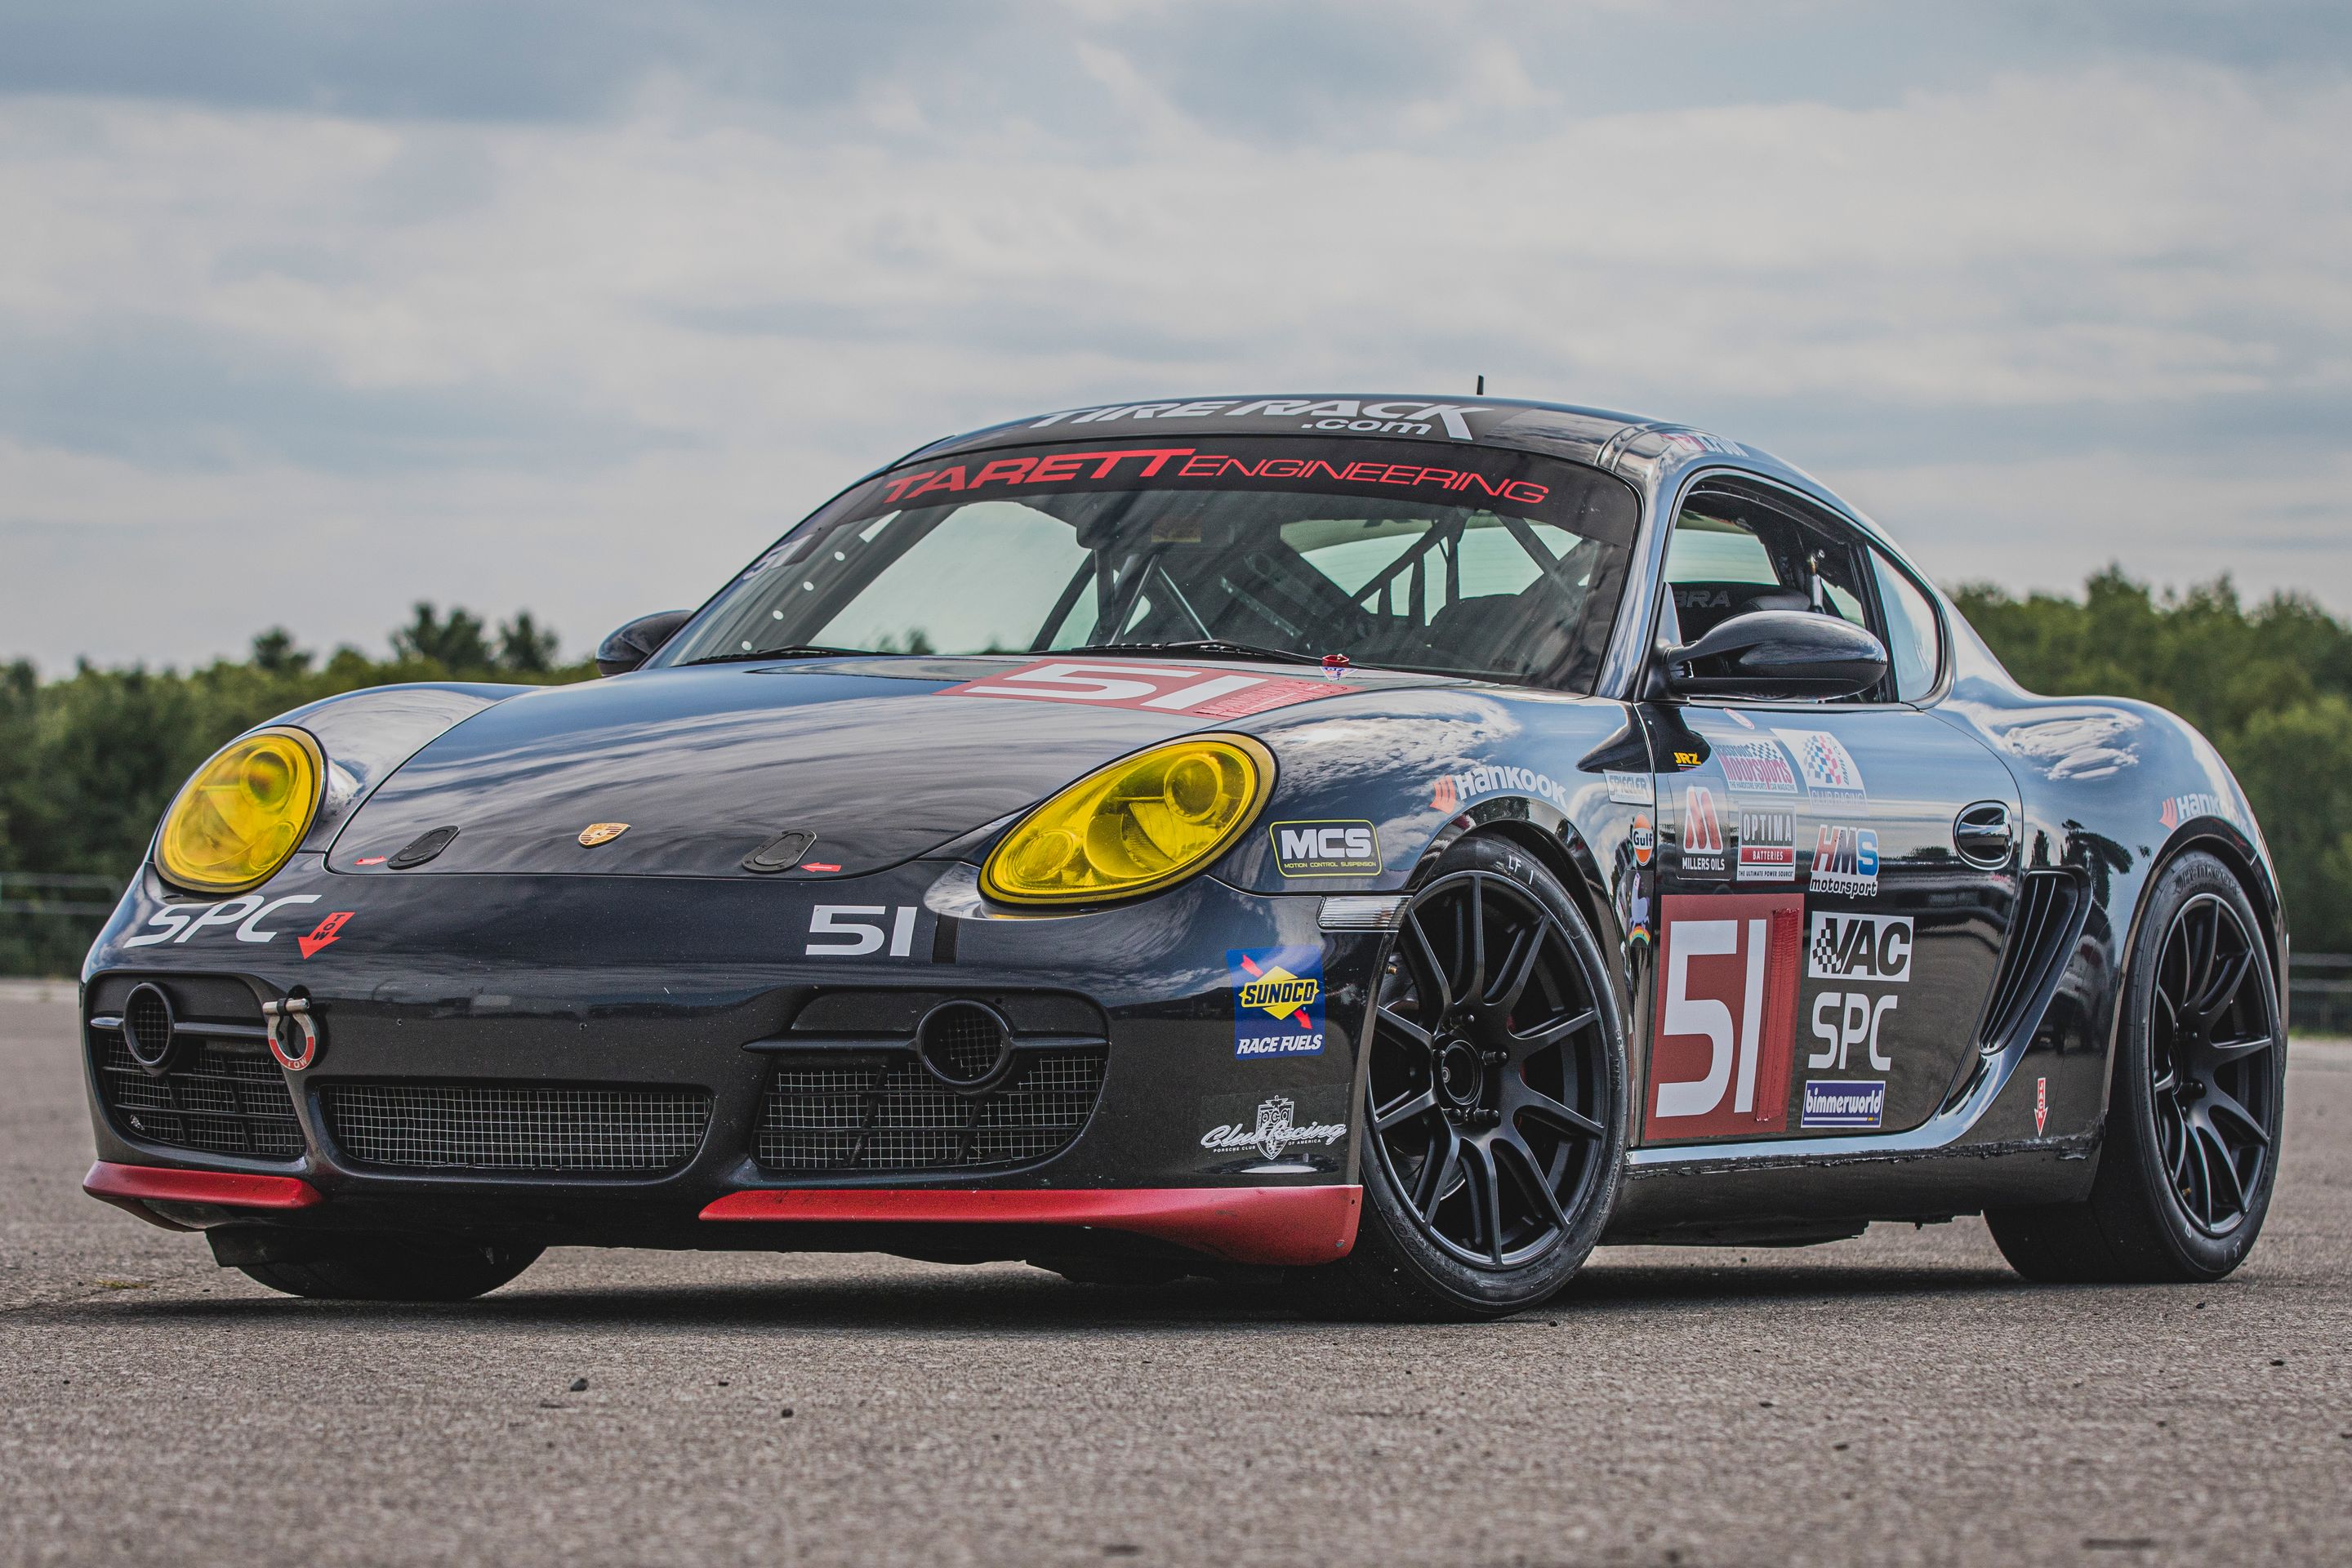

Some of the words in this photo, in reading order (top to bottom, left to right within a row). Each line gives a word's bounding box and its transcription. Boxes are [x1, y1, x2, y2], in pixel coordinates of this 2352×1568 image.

[1301, 417, 1432, 436] .com
[883, 448, 1196, 503] TARETT
[1178, 455, 1549, 504] ENGINEERING
[964, 663, 1270, 710] 51
[1673, 752, 1702, 764] JRZ
[1718, 753, 1793, 790] Motorsports
[1633, 831, 1654, 847] Gulf
[1743, 813, 1793, 842] OPTIMA
[1281, 828, 1372, 859] MCS
[1753, 850, 1784, 861] BATTERIES
[1811, 826, 1878, 876] HMS
[1682, 857, 1709, 871] MILLERS
[1711, 858, 1726, 871] OILS
[1811, 877, 1877, 898] motorsport
[122, 894, 323, 949] SPC
[312, 914, 344, 942] TOW
[805, 905, 918, 957] 51
[1812, 917, 1911, 977] VAC
[1244, 982, 1316, 1005] SUNOCO
[1655, 919, 1767, 1118] 51
[1807, 991, 1898, 1071] SPC
[1236, 1036, 1280, 1054] RACE
[1279, 1034, 1323, 1052] FUELS
[287, 1058, 307, 1068] TOW
[1806, 1087, 1882, 1113] bimmerworld
[1200, 1120, 1268, 1148] Club
